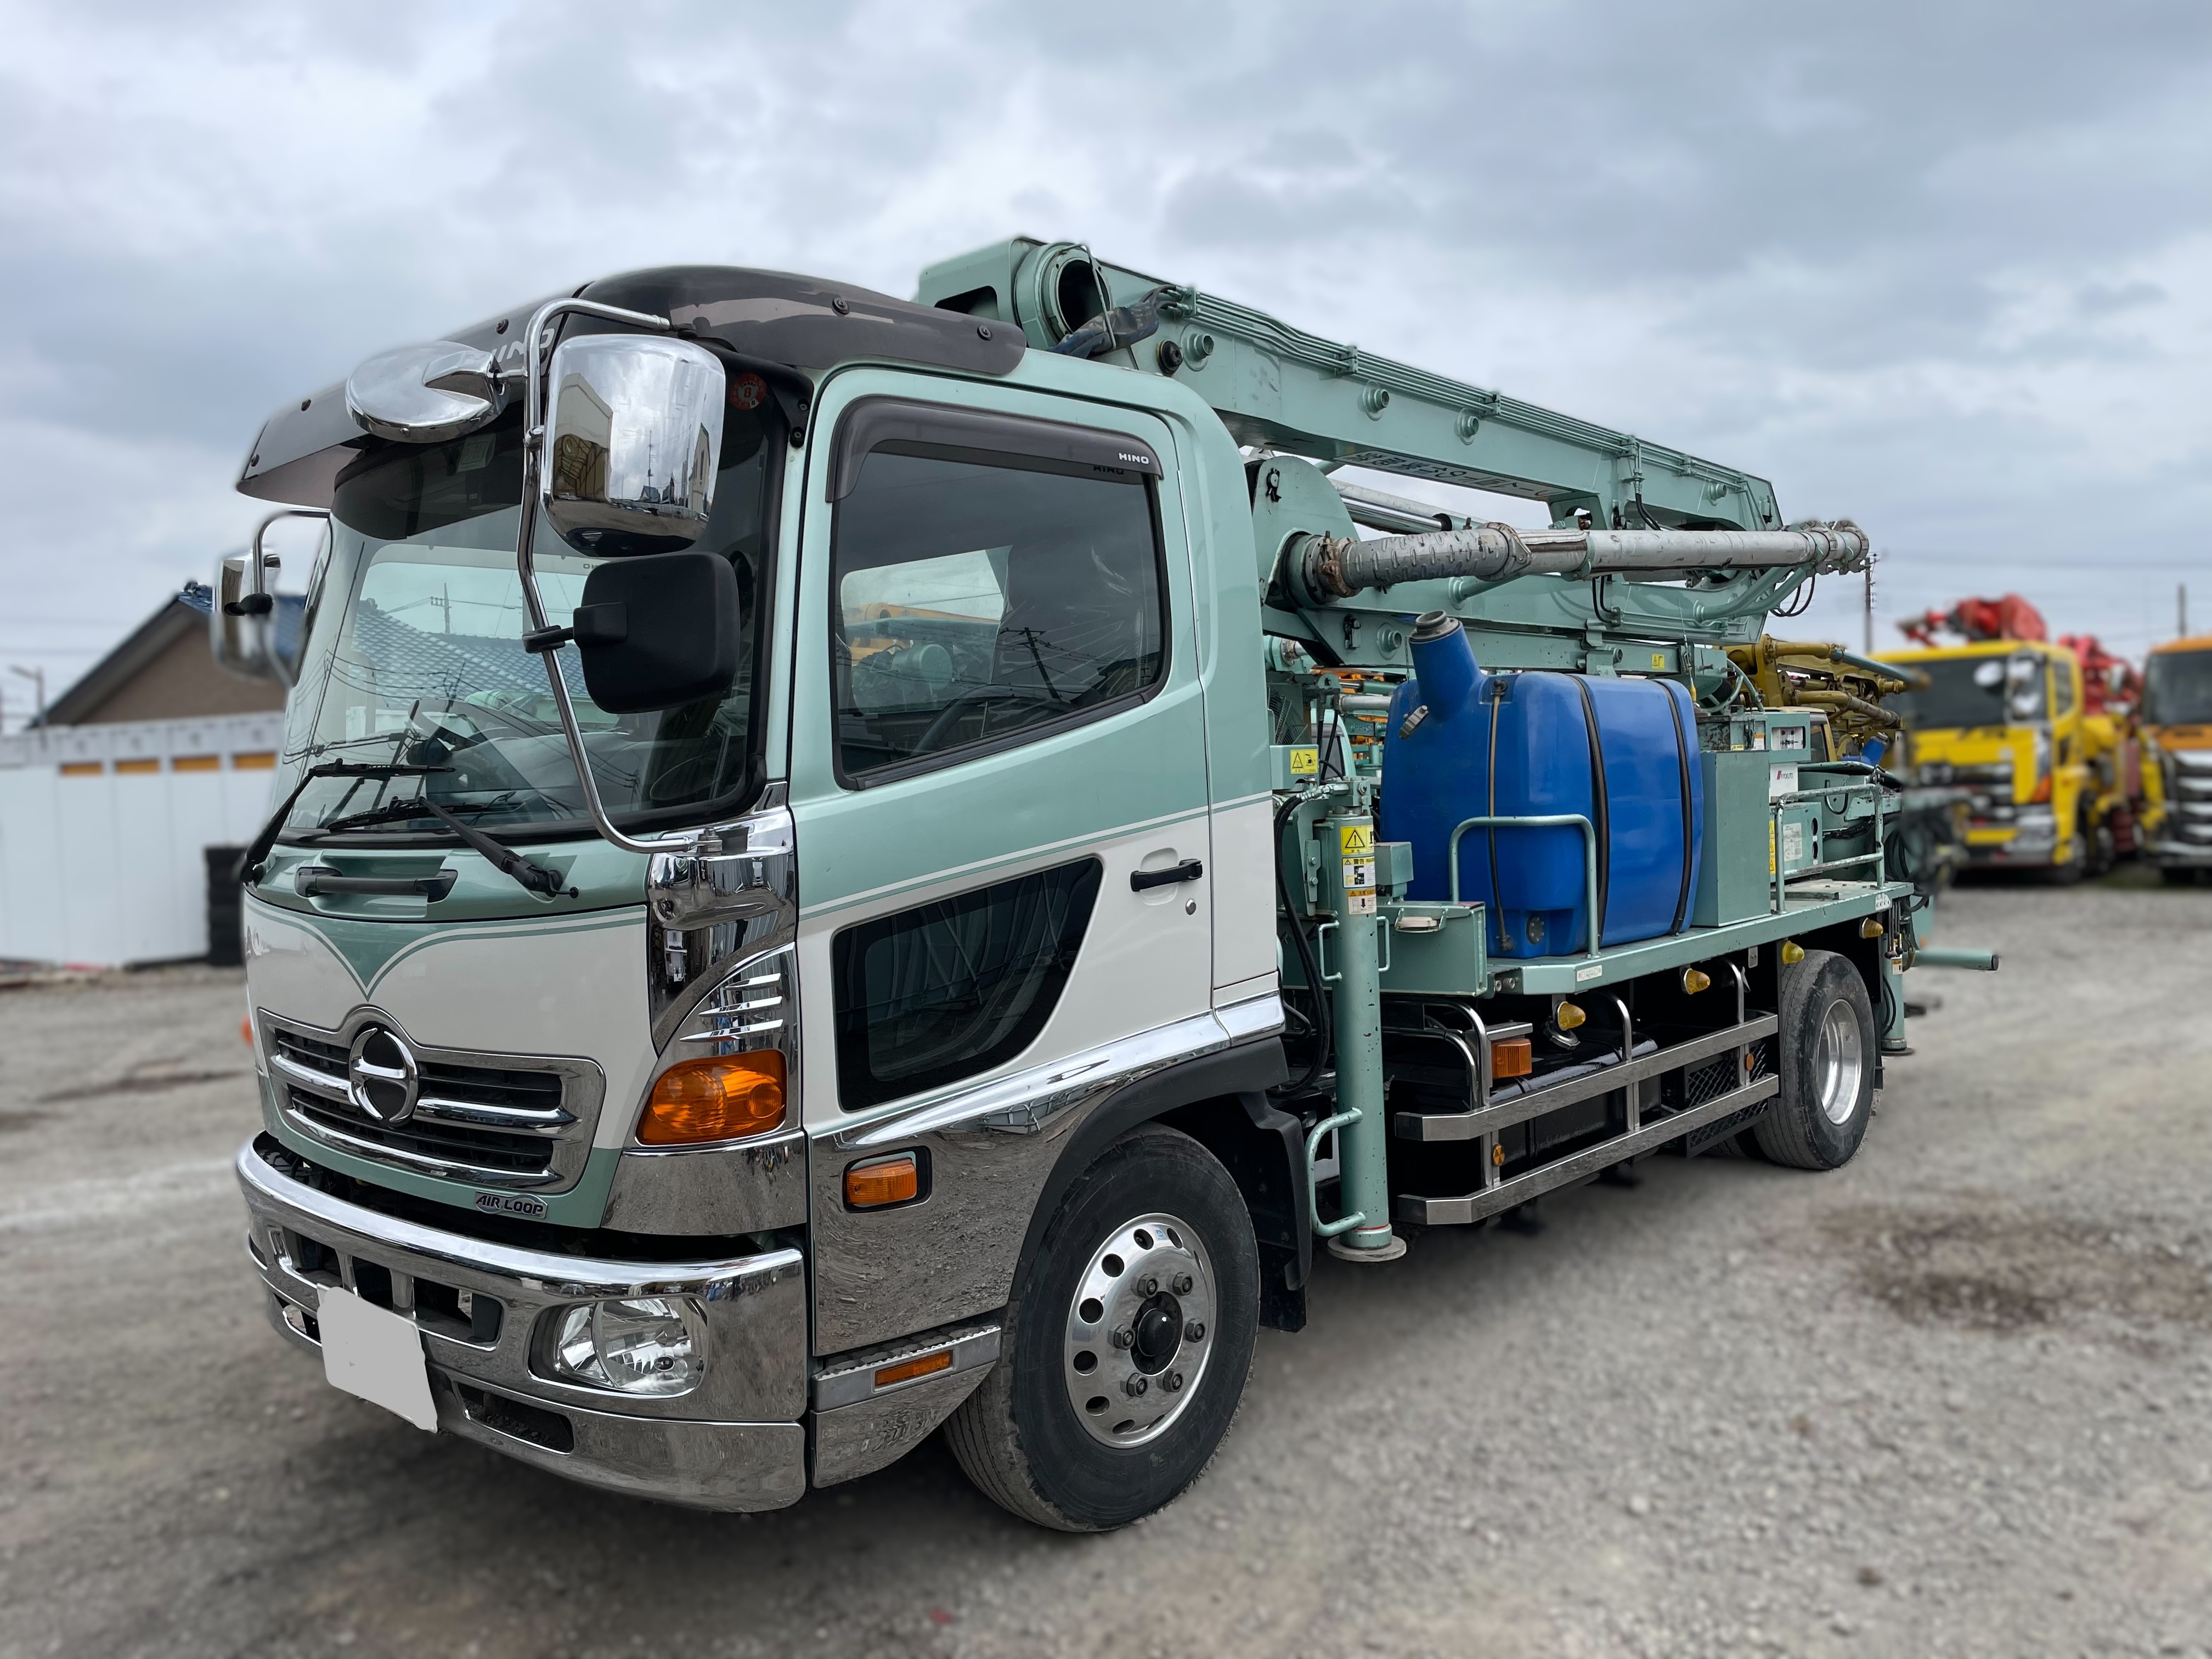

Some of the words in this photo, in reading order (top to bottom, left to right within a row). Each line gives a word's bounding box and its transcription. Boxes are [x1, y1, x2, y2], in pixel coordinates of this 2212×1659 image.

[492, 328, 555, 363] INO
[1119, 453, 1149, 464] HINO
[476, 1195, 500, 1209] AIR
[504, 1199, 544, 1215] LOOP
